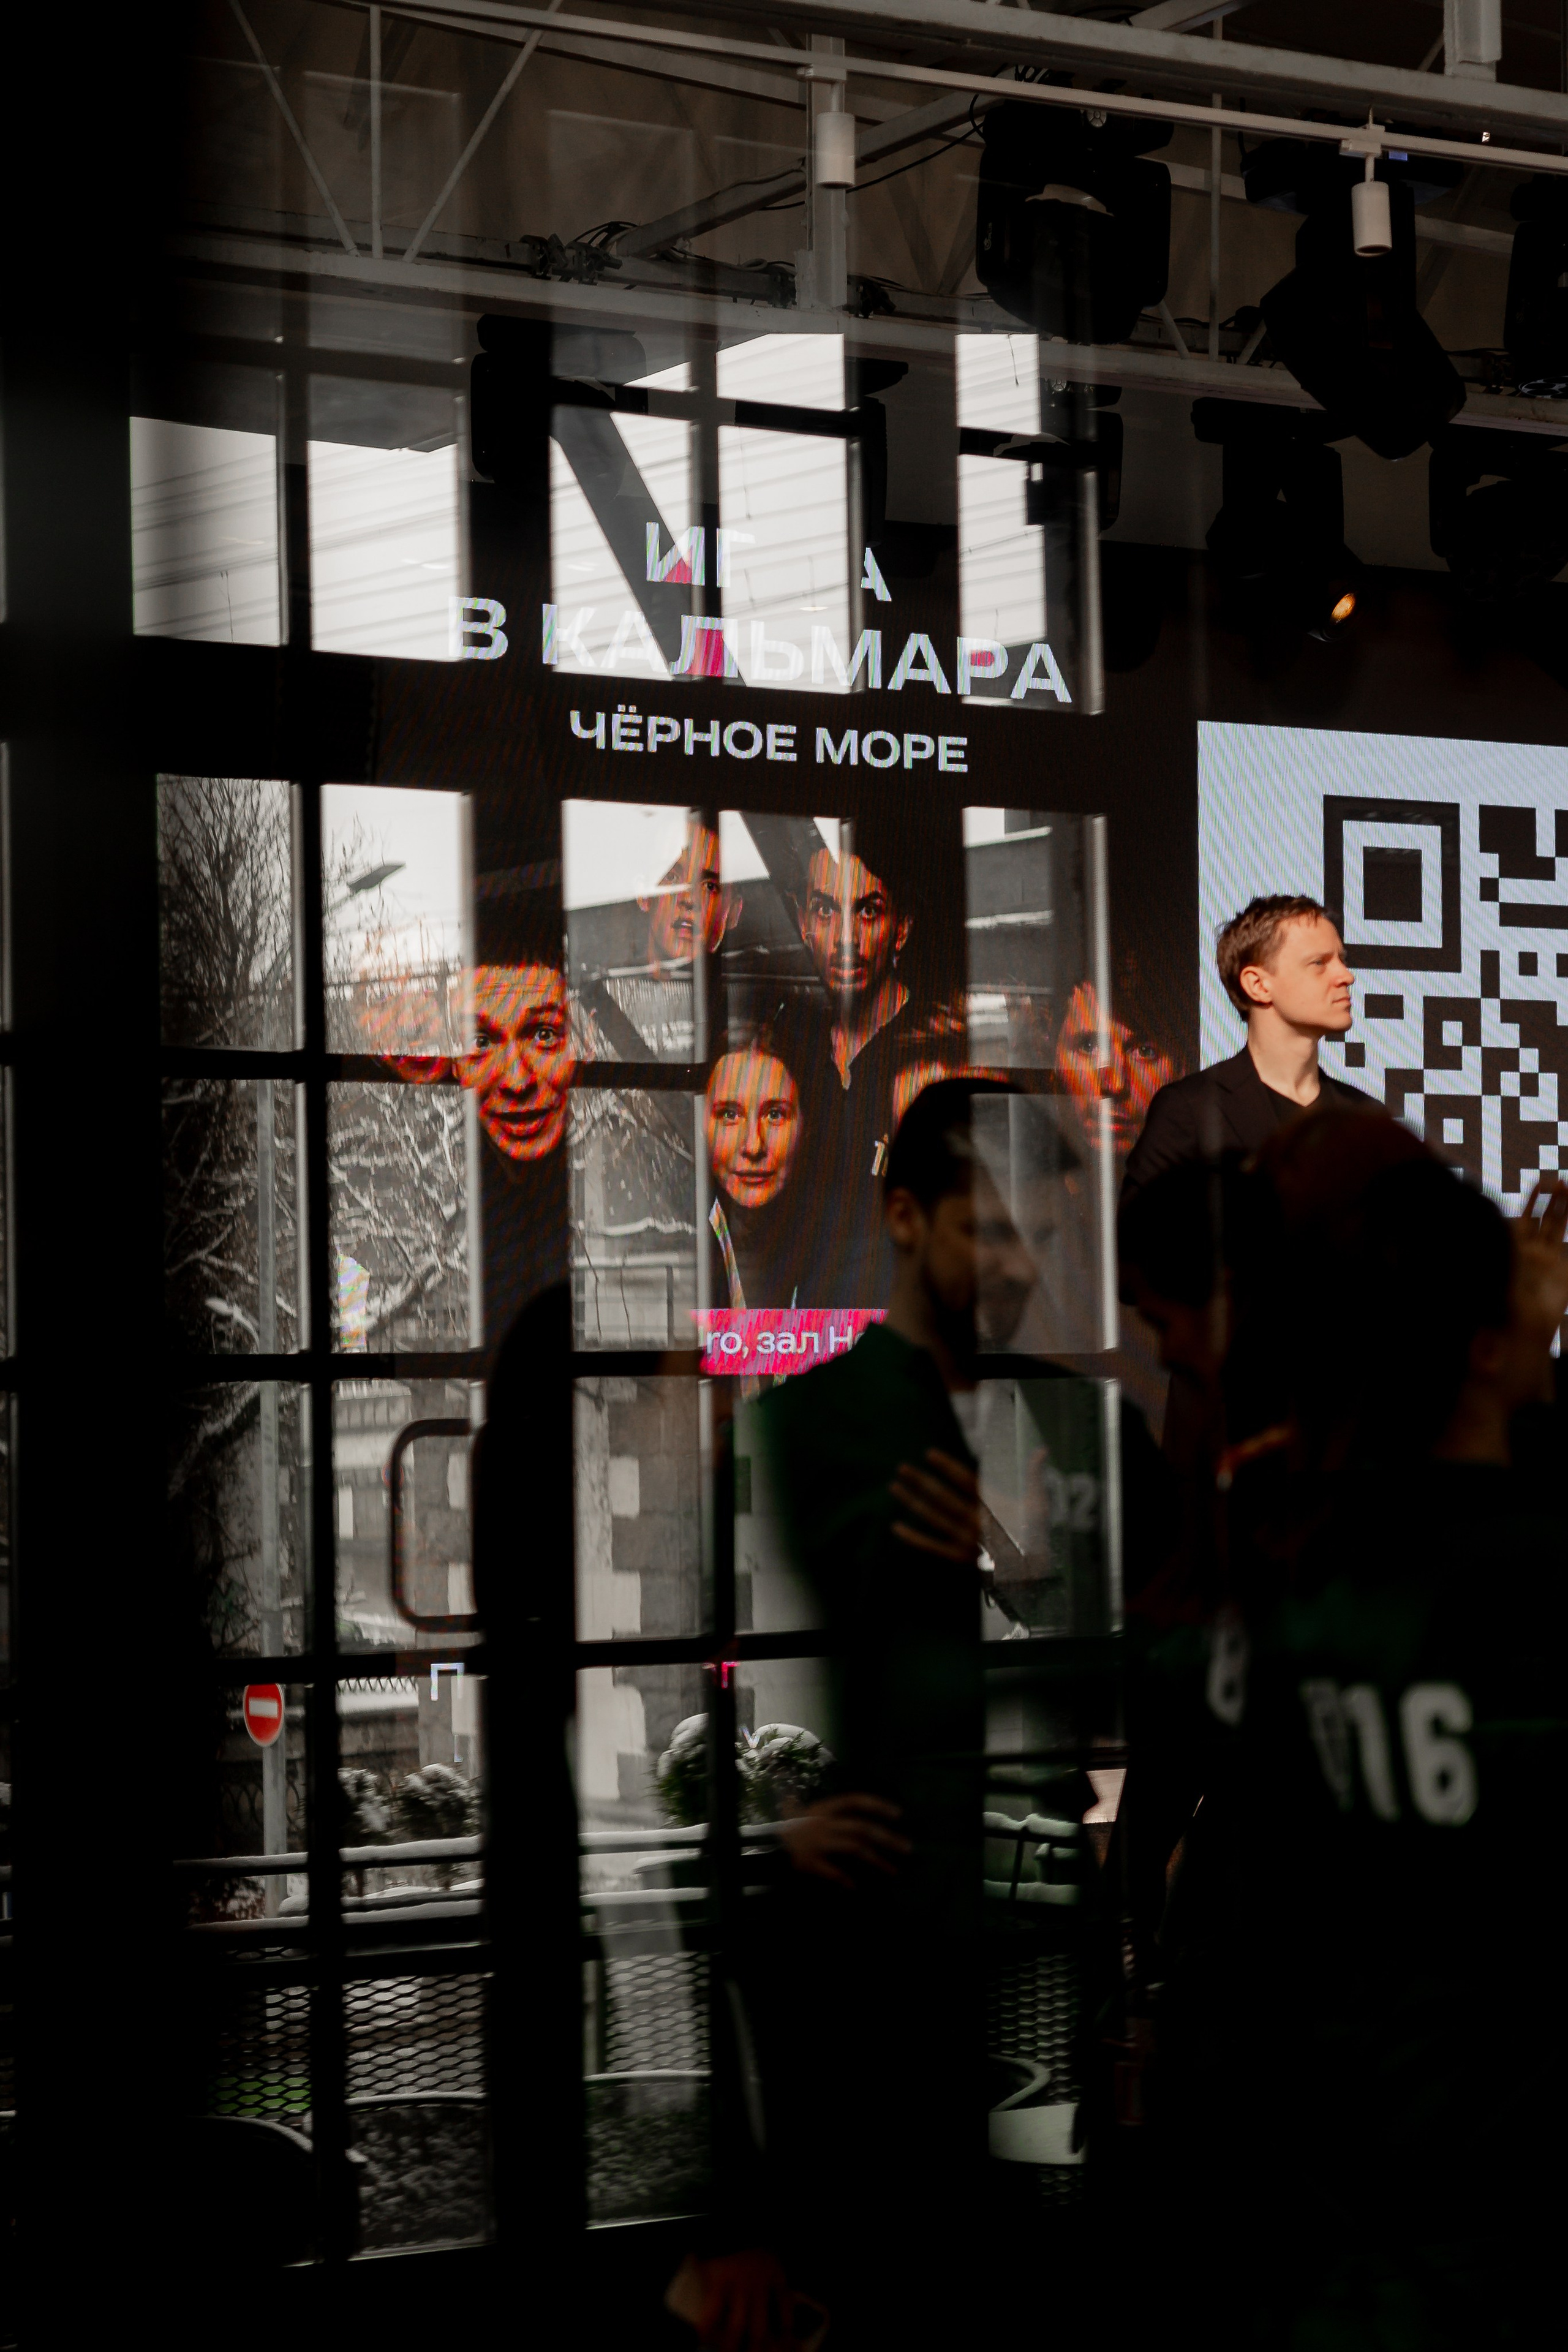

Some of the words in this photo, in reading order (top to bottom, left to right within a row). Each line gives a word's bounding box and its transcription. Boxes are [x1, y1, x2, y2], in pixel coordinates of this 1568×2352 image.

[646, 521, 892, 602] ИГА
[448, 596, 508, 661] В
[541, 603, 1072, 703] КАЛЬМАРА
[570, 704, 798, 763] ЧЁРНОЕ
[815, 726, 969, 773] МОРЕ
[757, 1330, 820, 1355] зал
[828, 1325, 865, 1354] Н
